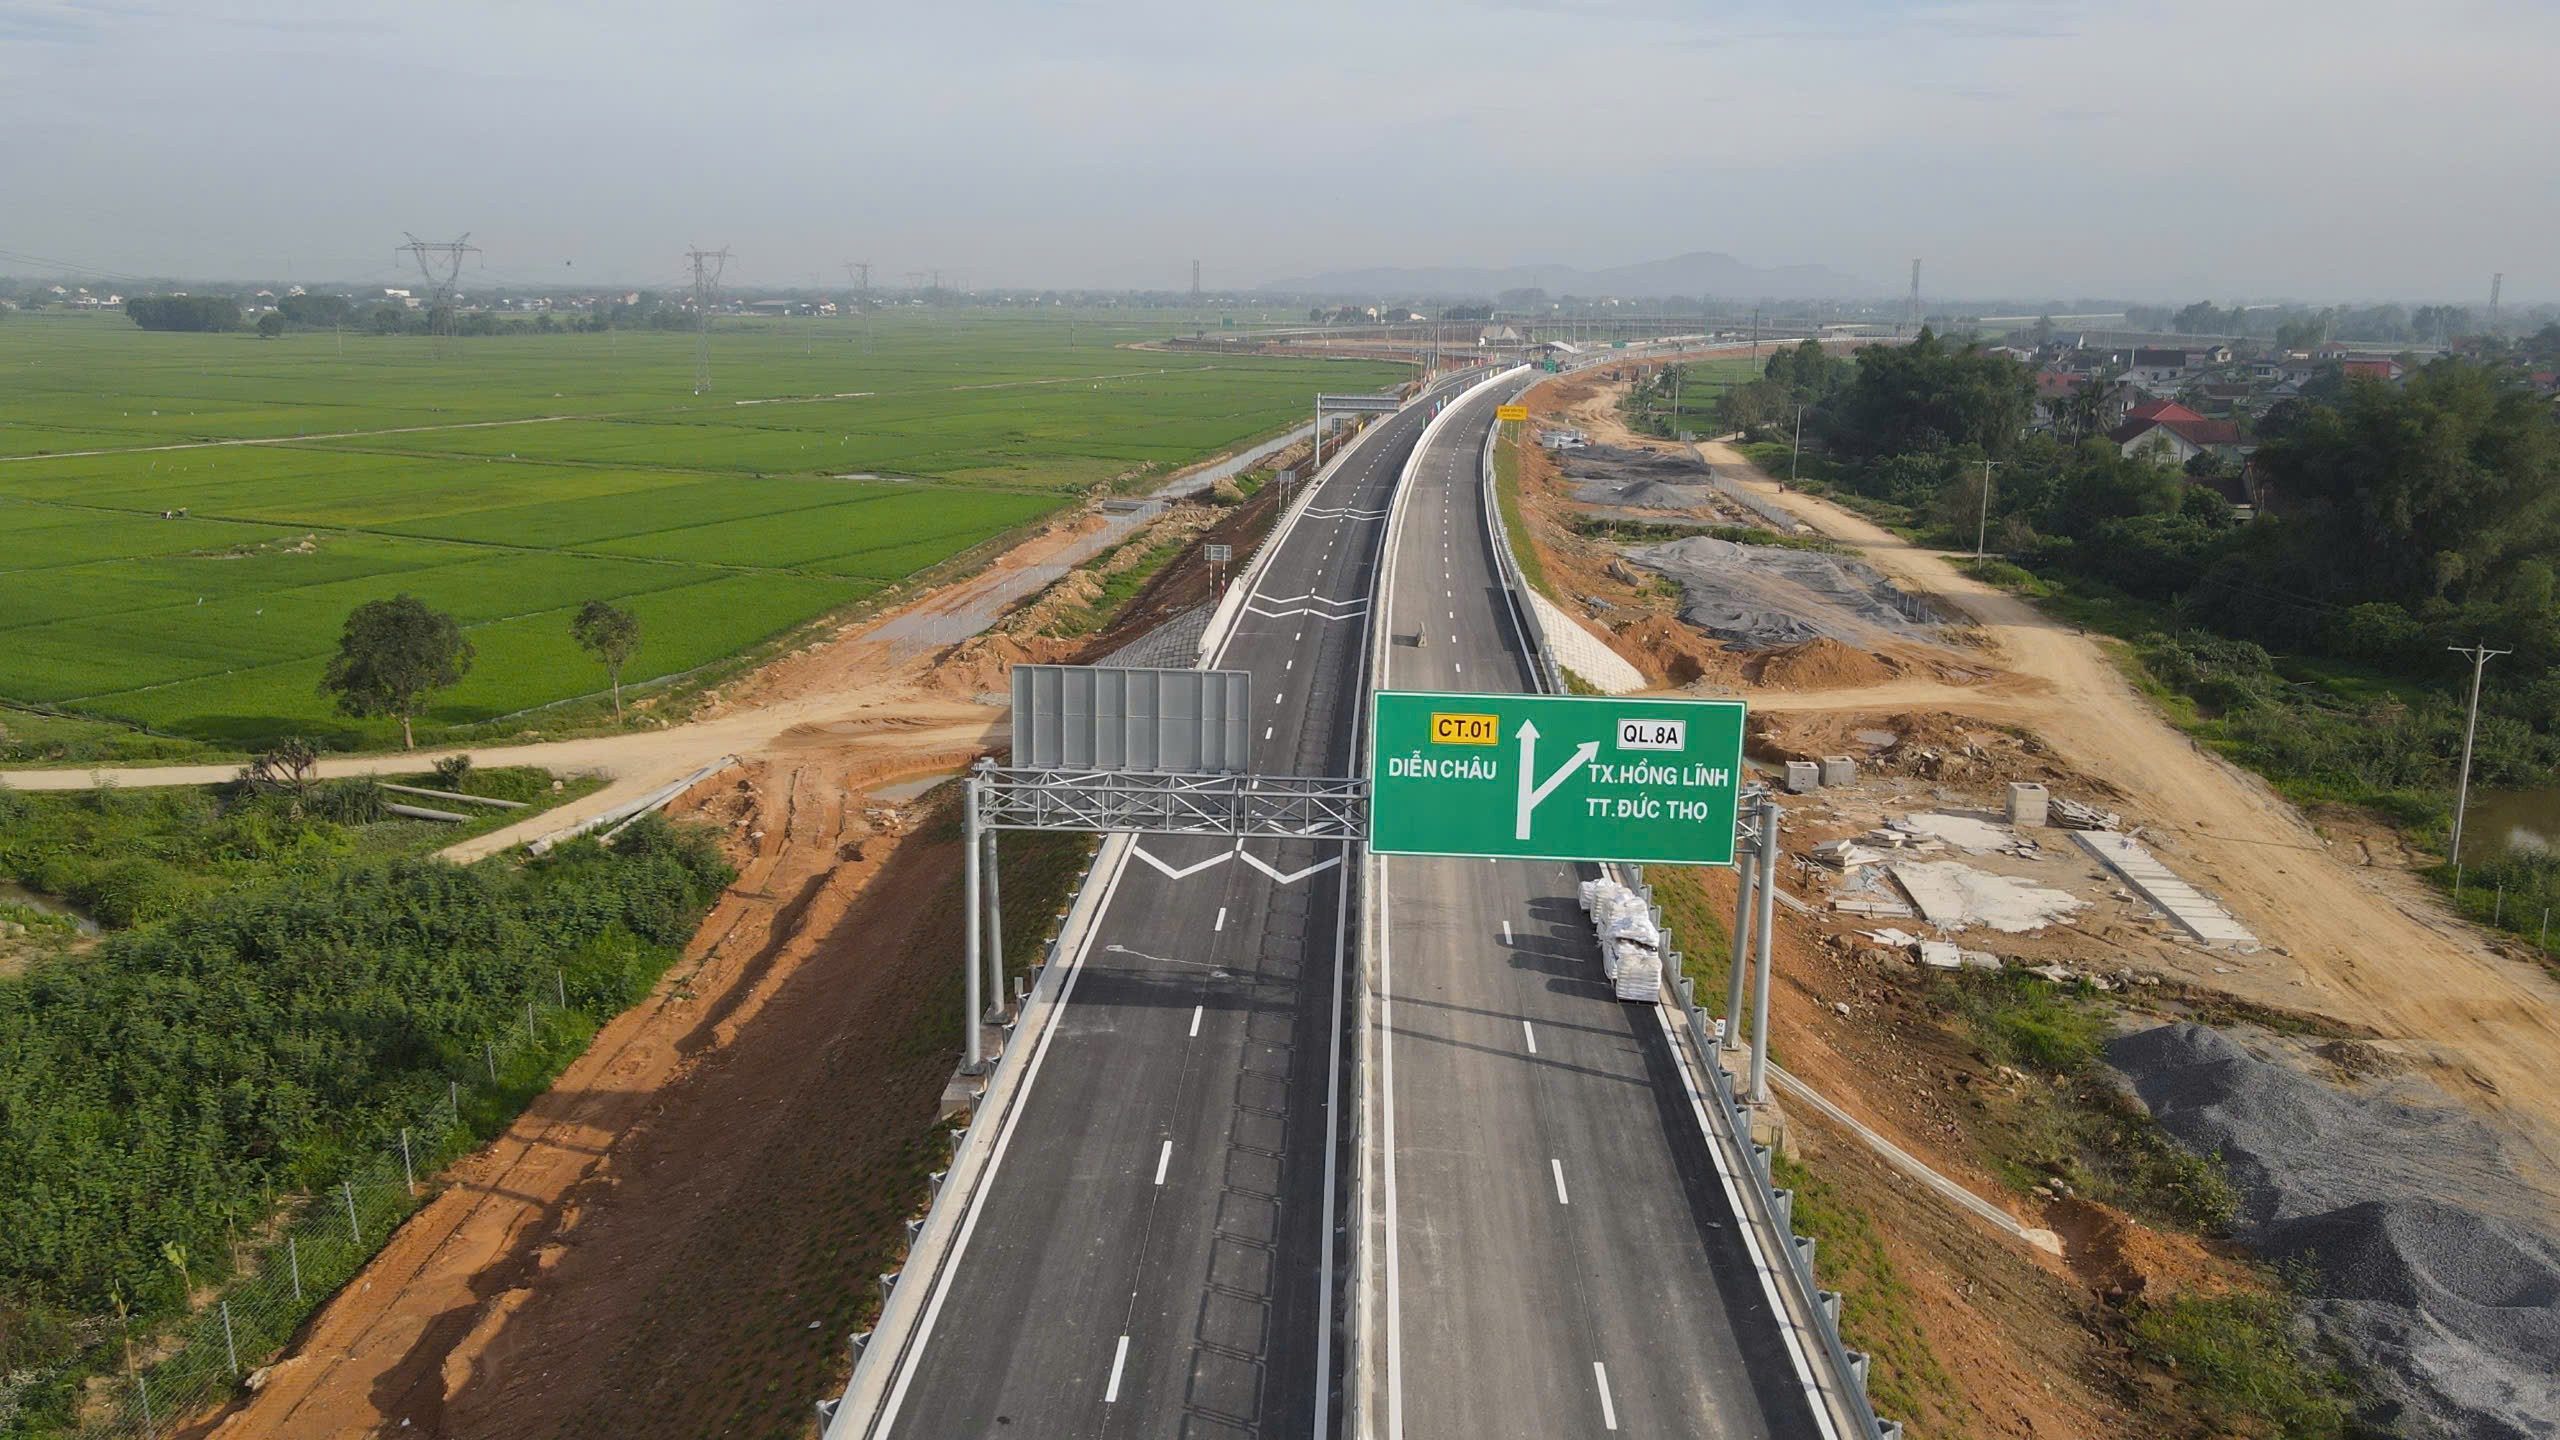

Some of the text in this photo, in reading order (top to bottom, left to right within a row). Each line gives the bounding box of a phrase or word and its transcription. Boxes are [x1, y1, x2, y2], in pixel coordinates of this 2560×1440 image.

[1438, 718, 1491, 738] CT.01
[1623, 725, 1679, 745] QL.8A
[1388, 750, 1497, 780] DIỄN CHÂU
[1588, 758, 1729, 787] TX.HỒNG LĨNH
[1585, 793, 1709, 824] TT.ĐỨC THỌ
